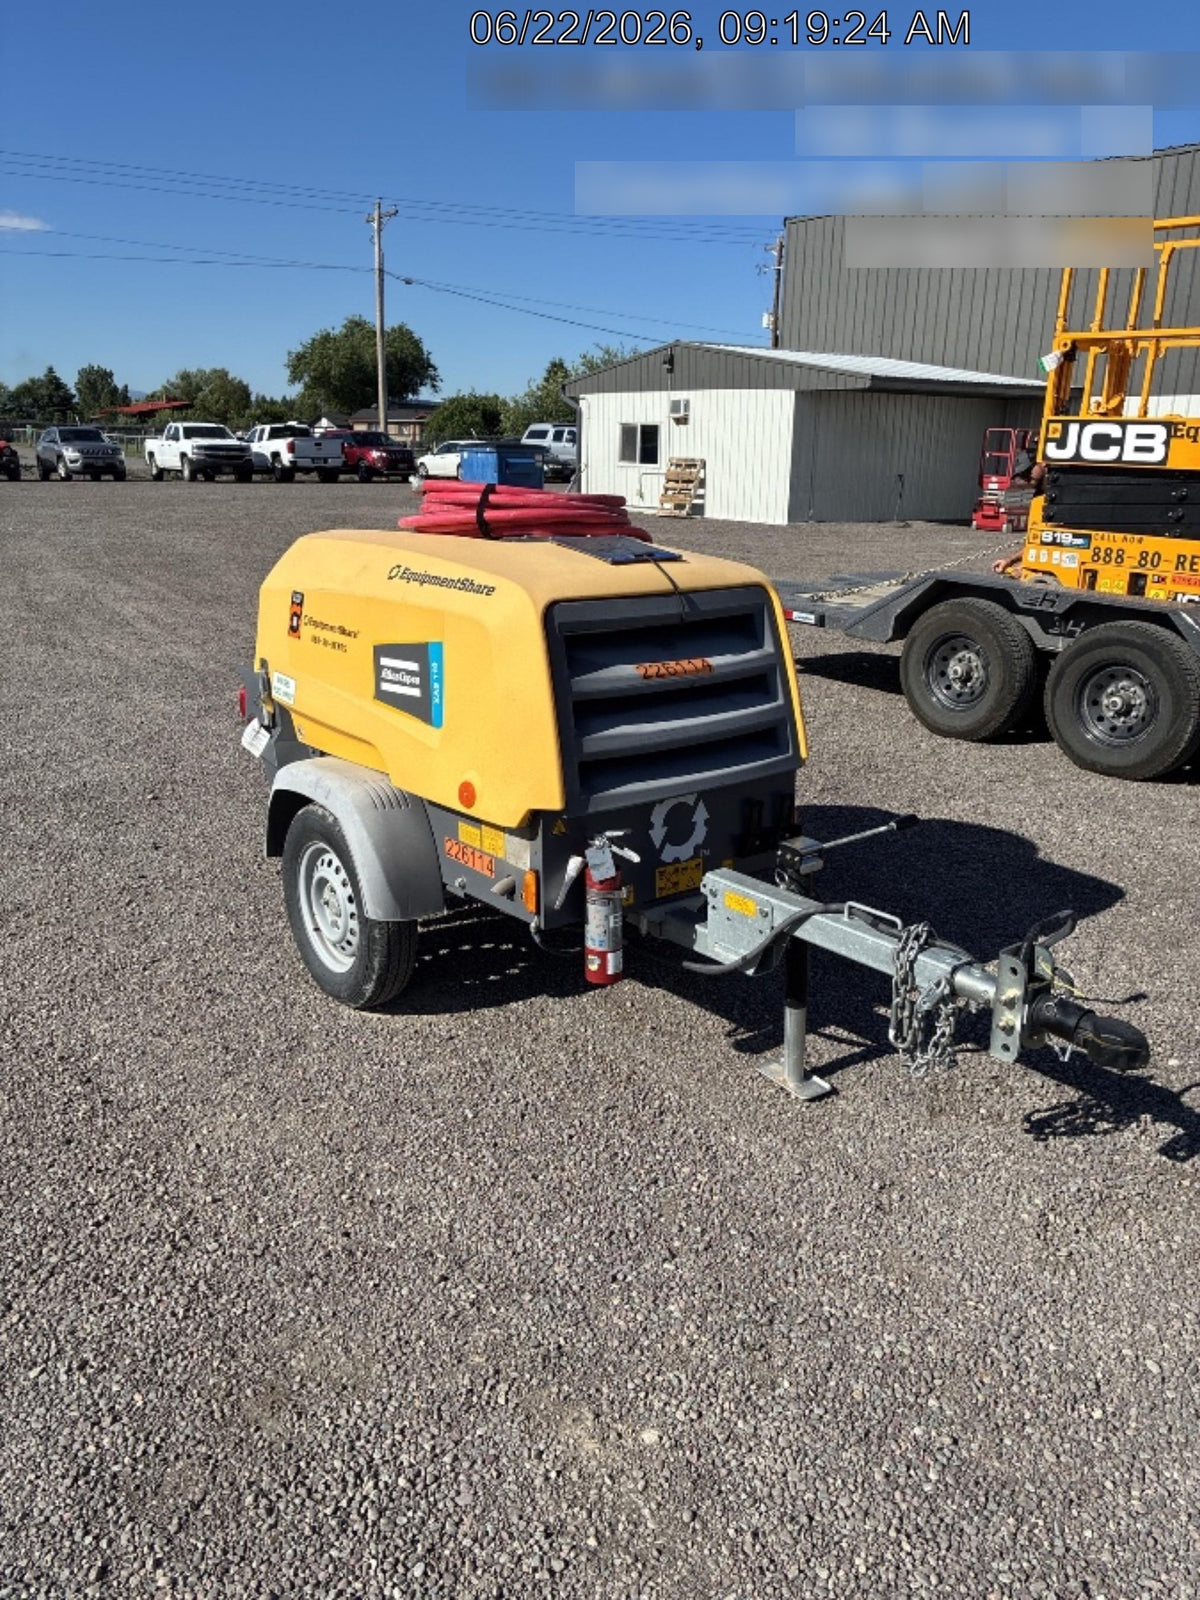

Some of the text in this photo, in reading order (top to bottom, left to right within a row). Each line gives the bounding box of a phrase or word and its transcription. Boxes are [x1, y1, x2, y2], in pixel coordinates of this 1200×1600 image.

[1045, 422, 1168, 463] JCB
[1093, 532, 1118, 543] CALL
[399, 566, 496, 597] EquipmentShare
[635, 658, 715, 680] 226114
[445, 837, 494, 877] 226114
